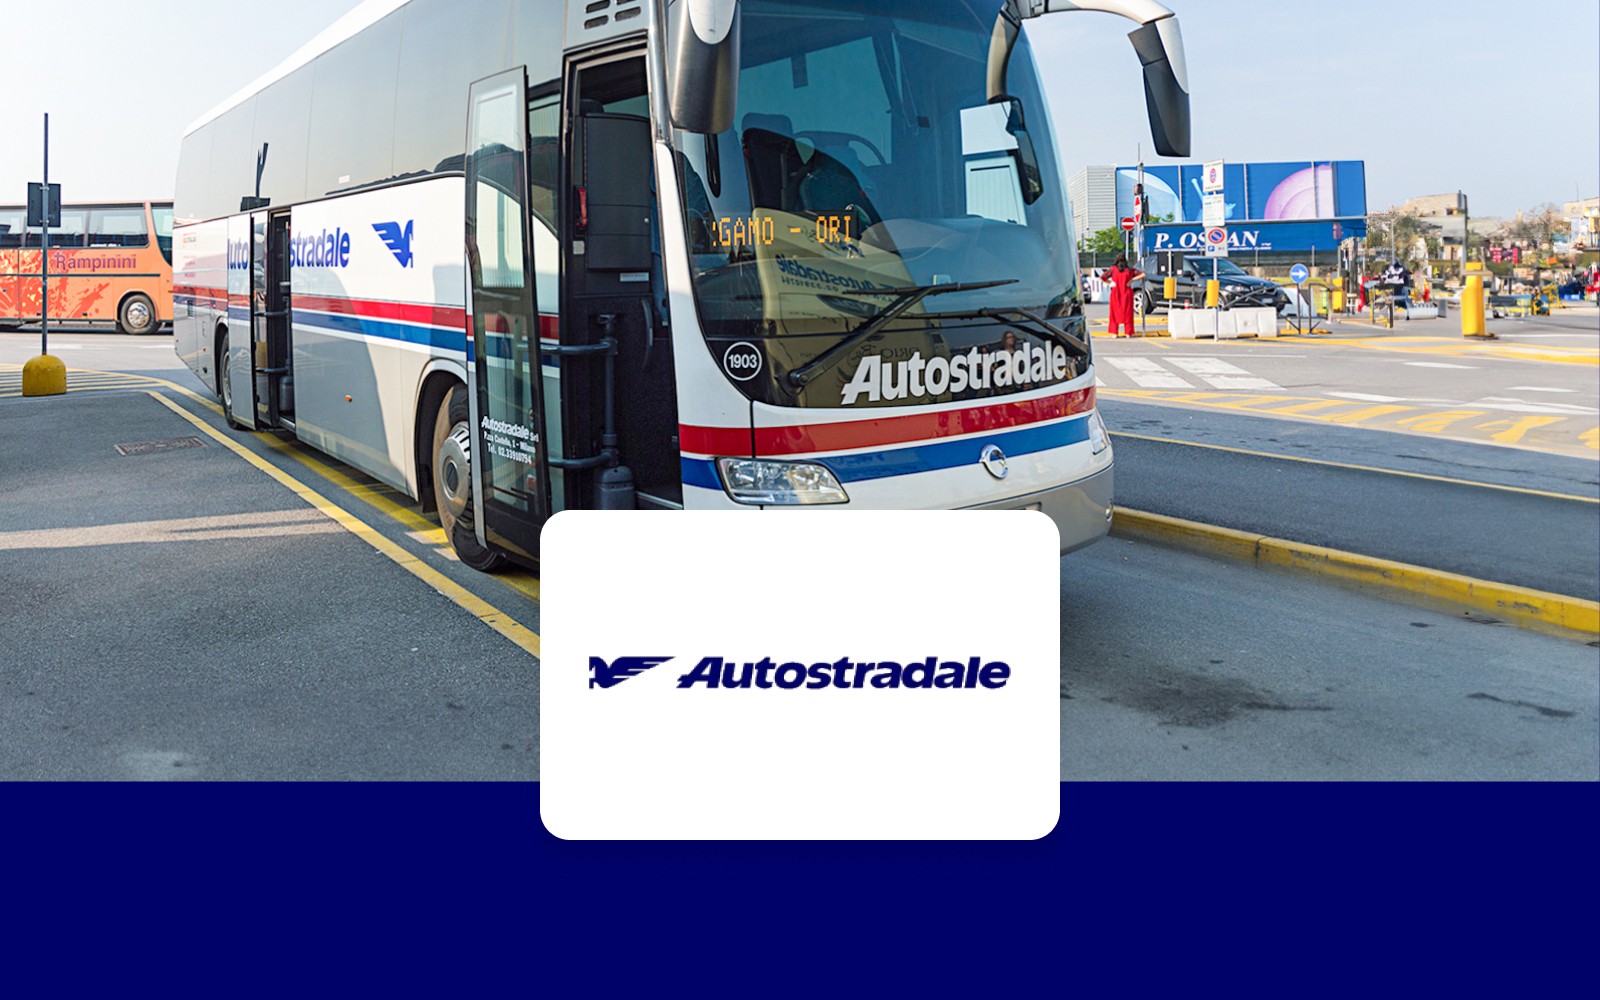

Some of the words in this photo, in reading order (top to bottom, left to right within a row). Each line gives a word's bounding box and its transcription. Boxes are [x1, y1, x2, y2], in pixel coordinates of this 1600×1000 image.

[712, 217, 774, 247] GAMO
[816, 215, 852, 243] ORI
[1154, 232, 1174, 249] P.
[1179, 231, 1259, 248] OSAN
[54, 252, 137, 272] Rampinini
[728, 353, 757, 369] 1903
[841, 340, 1067, 405] Autostradale
[481, 415, 529, 440] Autostradale
